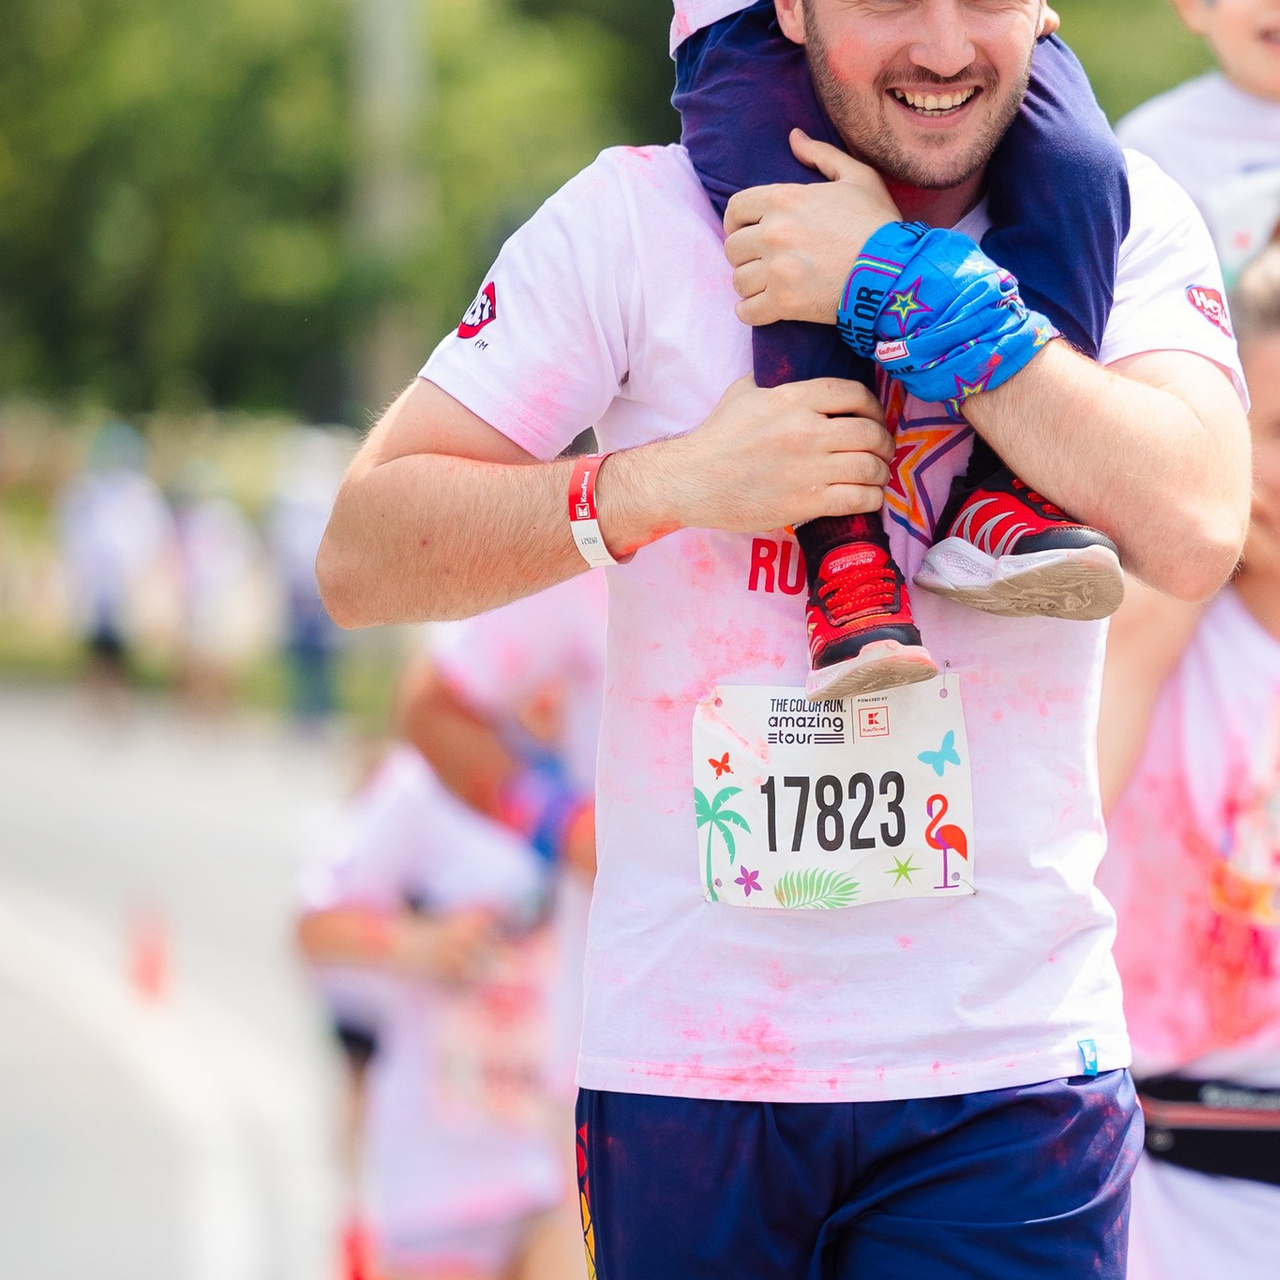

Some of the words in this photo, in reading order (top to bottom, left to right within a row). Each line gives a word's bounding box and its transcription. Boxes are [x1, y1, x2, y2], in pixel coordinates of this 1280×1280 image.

[474, 339, 489, 351] FM
[580, 471, 590, 503] Kaufland
[748, 538, 811, 596] RU
[770, 698, 789, 713] THE
[790, 698, 822, 713] COLOR
[768, 714, 844, 732] amazing
[778, 730, 813, 745] tour
[760, 770, 906, 853] 17823
